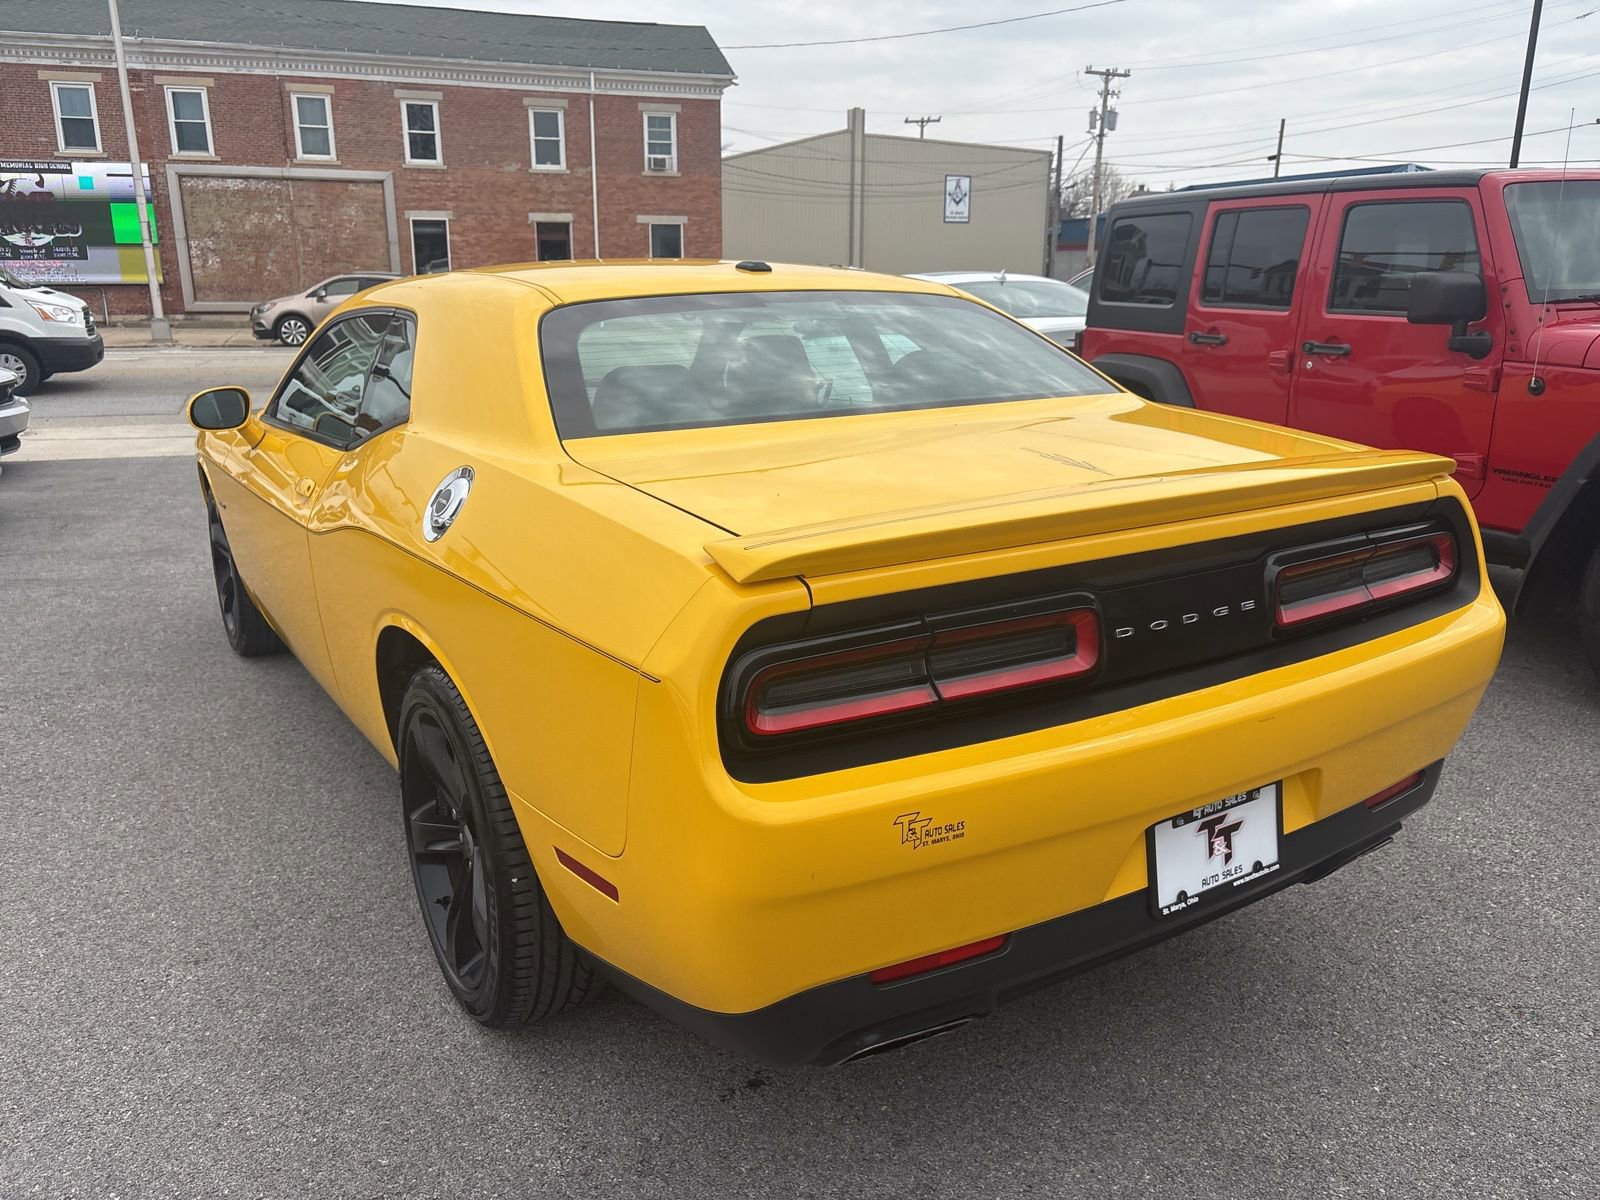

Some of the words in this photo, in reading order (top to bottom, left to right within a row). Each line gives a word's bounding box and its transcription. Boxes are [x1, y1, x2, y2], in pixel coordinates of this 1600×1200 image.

[1115, 600, 1256, 638] DODGE
[1204, 800, 1223, 816] AUTO
[1225, 791, 1247, 807] SALES
[893, 811, 933, 850] T&T
[925, 826, 942, 839] AUTO
[944, 821, 965, 834] SALES
[952, 832, 965, 840] OHIO
[1195, 812, 1245, 867] T&T
[1202, 873, 1220, 888] AUTO
[1222, 864, 1243, 879] SALES
[1187, 896, 1199, 906] Ohio
